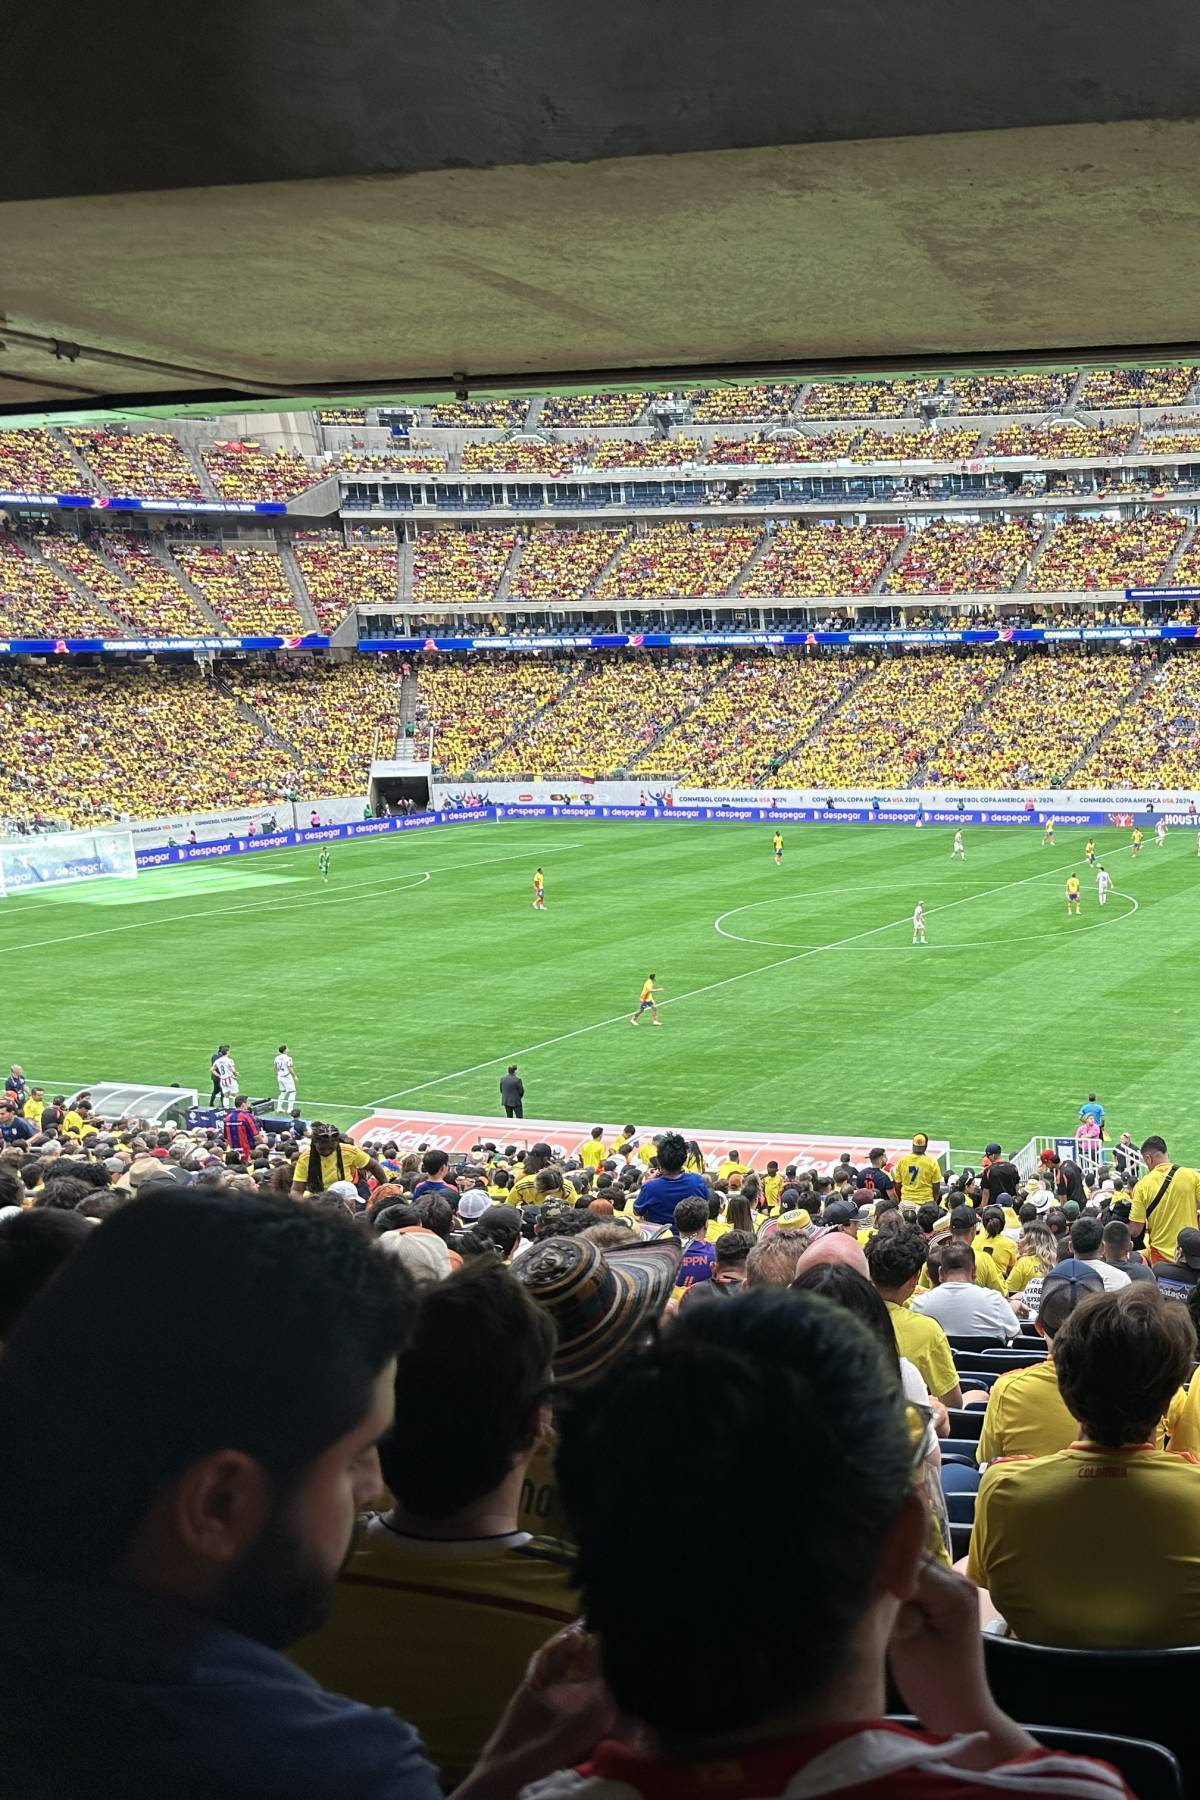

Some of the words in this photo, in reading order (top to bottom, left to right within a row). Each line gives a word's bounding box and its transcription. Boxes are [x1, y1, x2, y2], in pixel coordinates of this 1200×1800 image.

[449, 810, 488, 821] despegar
[562, 808, 596, 817] despegar
[611, 808, 647, 818] despegar
[662, 809, 700, 818] despegar
[716, 810, 753, 819] despegar
[768, 810, 806, 820] despegar
[822, 811, 861, 820] despegar
[878, 812, 917, 822] despegar
[934, 812, 974, 822] despegar
[404, 816, 436, 827] despegar
[991, 813, 1031, 823] despegar
[356, 822, 390, 833] despegar
[304, 828, 340, 840] despegar
[249, 836, 288, 848] despegar
[190, 844, 231, 857] despegar
[137, 853, 170, 866] spegar
[908, 1166, 920, 1185] 7
[1078, 1466, 1128, 1479] COLOMBIA
